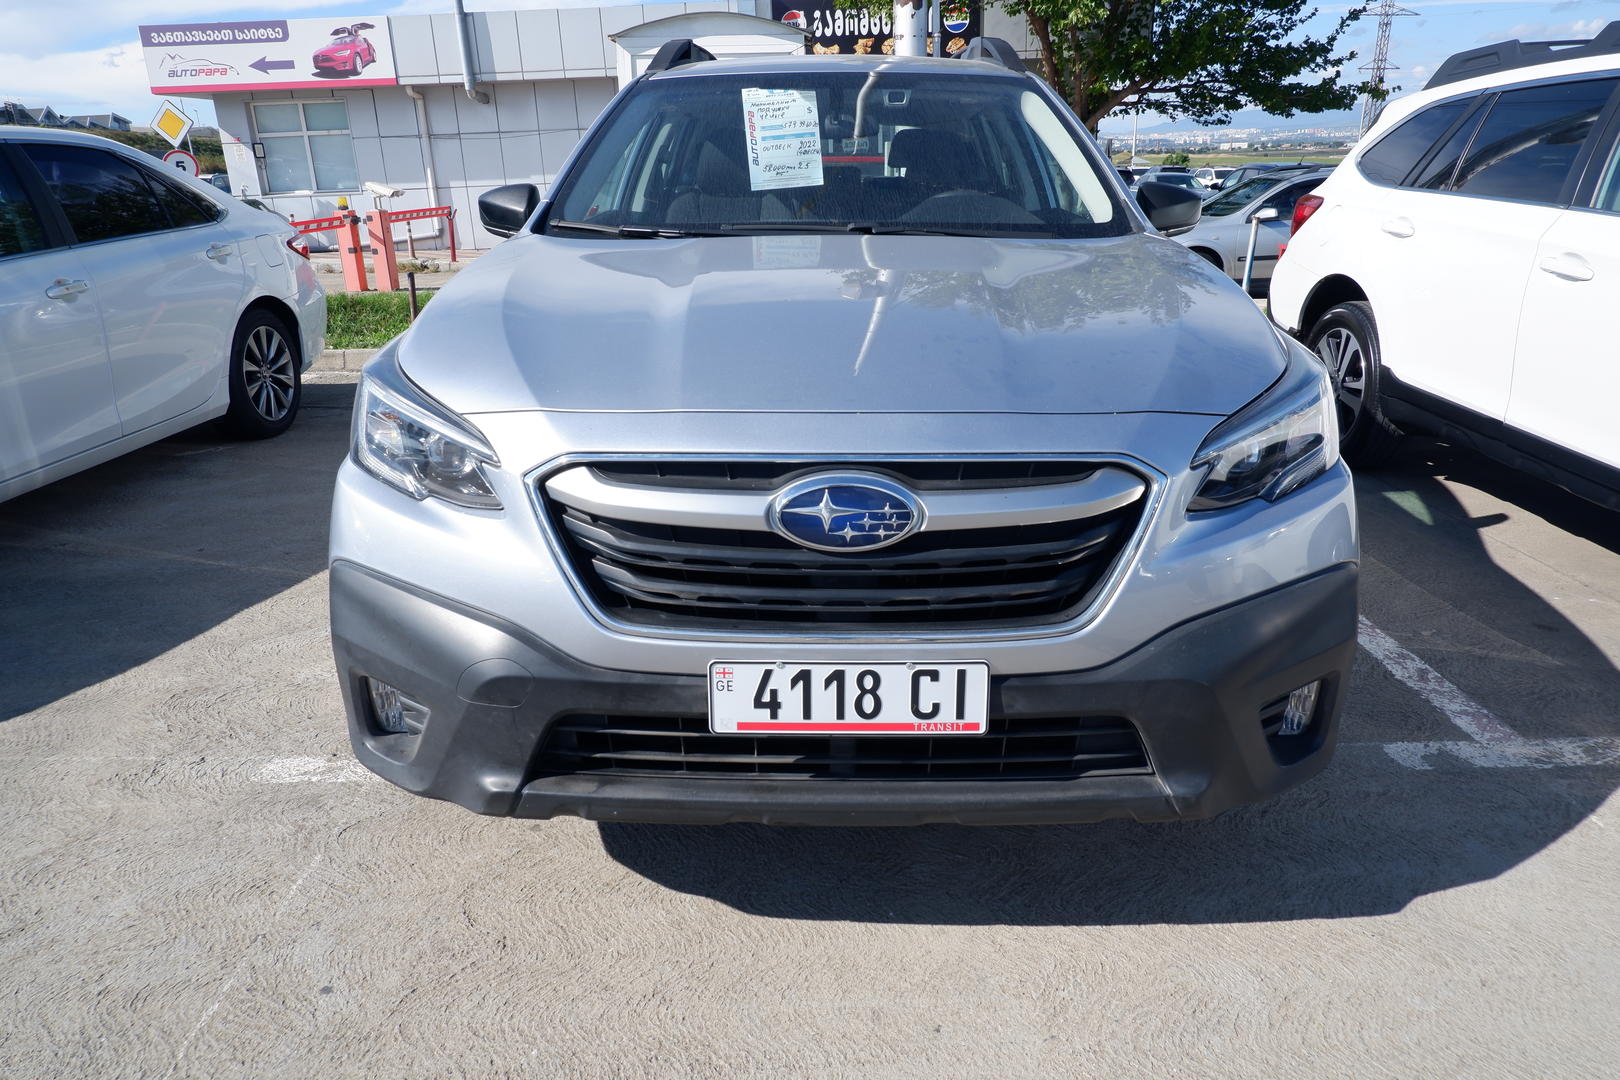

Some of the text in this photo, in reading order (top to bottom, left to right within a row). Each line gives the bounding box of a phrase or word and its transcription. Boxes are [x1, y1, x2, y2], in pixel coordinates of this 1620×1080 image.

[234, 27, 283, 40] საიტზე
[175, 160, 187, 172] 5
[715, 680, 734, 692] GE
[753, 668, 967, 721] 4118 CI
[912, 722, 965, 732] TRANSIT
